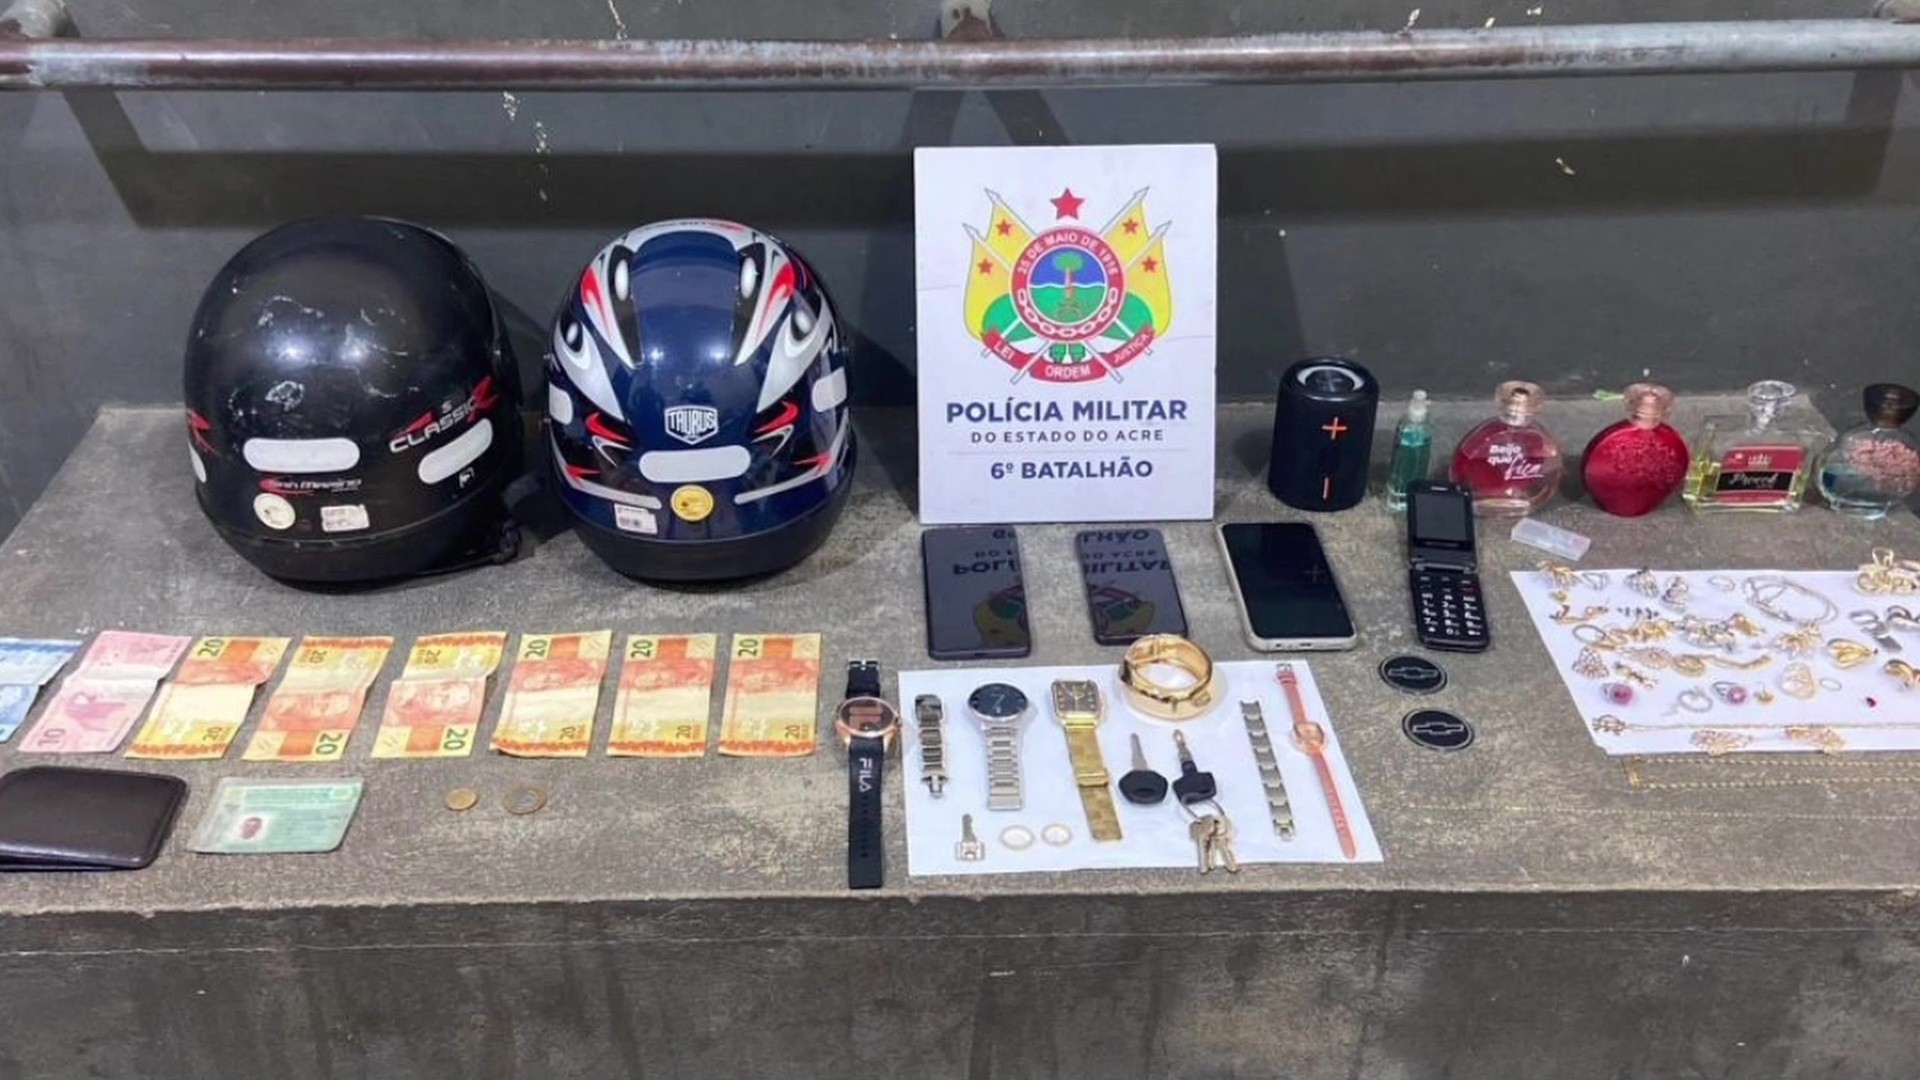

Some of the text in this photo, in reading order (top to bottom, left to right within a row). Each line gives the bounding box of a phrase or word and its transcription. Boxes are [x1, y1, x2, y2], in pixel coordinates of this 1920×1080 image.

[1029, 240, 1044, 258] DE
[1044, 231, 1078, 246] MAIO
[1079, 236, 1099, 251] DE
[993, 339, 1014, 360] LEI
[1044, 364, 1092, 378] ORDEM
[947, 397, 1187, 422] POLÍCIA MILITAR
[389, 396, 477, 453] CLASSIC
[668, 409, 716, 435] TAURUS
[971, 429, 1163, 443] DO ESTADO DO ACRE
[991, 456, 1153, 480] 6º BATALHÃO
[1487, 456, 1513, 466] que
[197, 638, 225, 658] 20
[308, 650, 328, 664] 20
[525, 639, 548, 659] 20
[631, 639, 653, 659] 20
[737, 638, 759, 657] 20
[443, 728, 469, 751] 20
[559, 725, 577, 740] 20
[676, 725, 693, 740] 20
[785, 724, 801, 740] 20
[316, 733, 343, 755] 20
[859, 757, 873, 792] FILA
